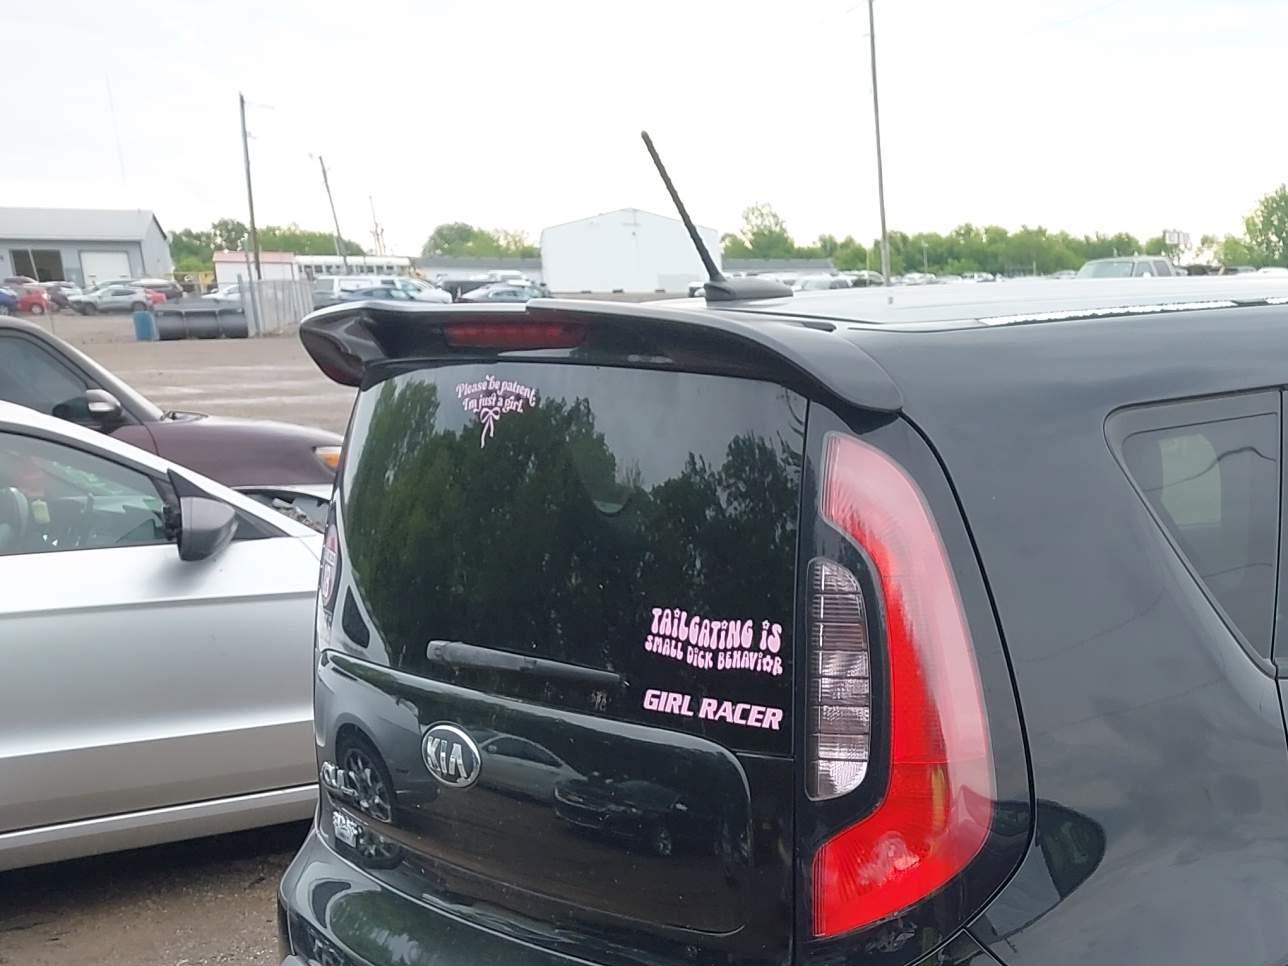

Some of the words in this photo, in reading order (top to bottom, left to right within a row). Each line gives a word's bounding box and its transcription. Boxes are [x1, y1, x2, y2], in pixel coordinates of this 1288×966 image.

[456, 382, 488, 398] Please
[486, 375, 500, 390] be
[473, 392, 497, 413] just
[497, 396, 503, 406] a
[644, 635, 684, 660] SMALL
[643, 689, 694, 716] GIRL
[698, 697, 783, 730] RACER
[427, 735, 468, 778] KIA
